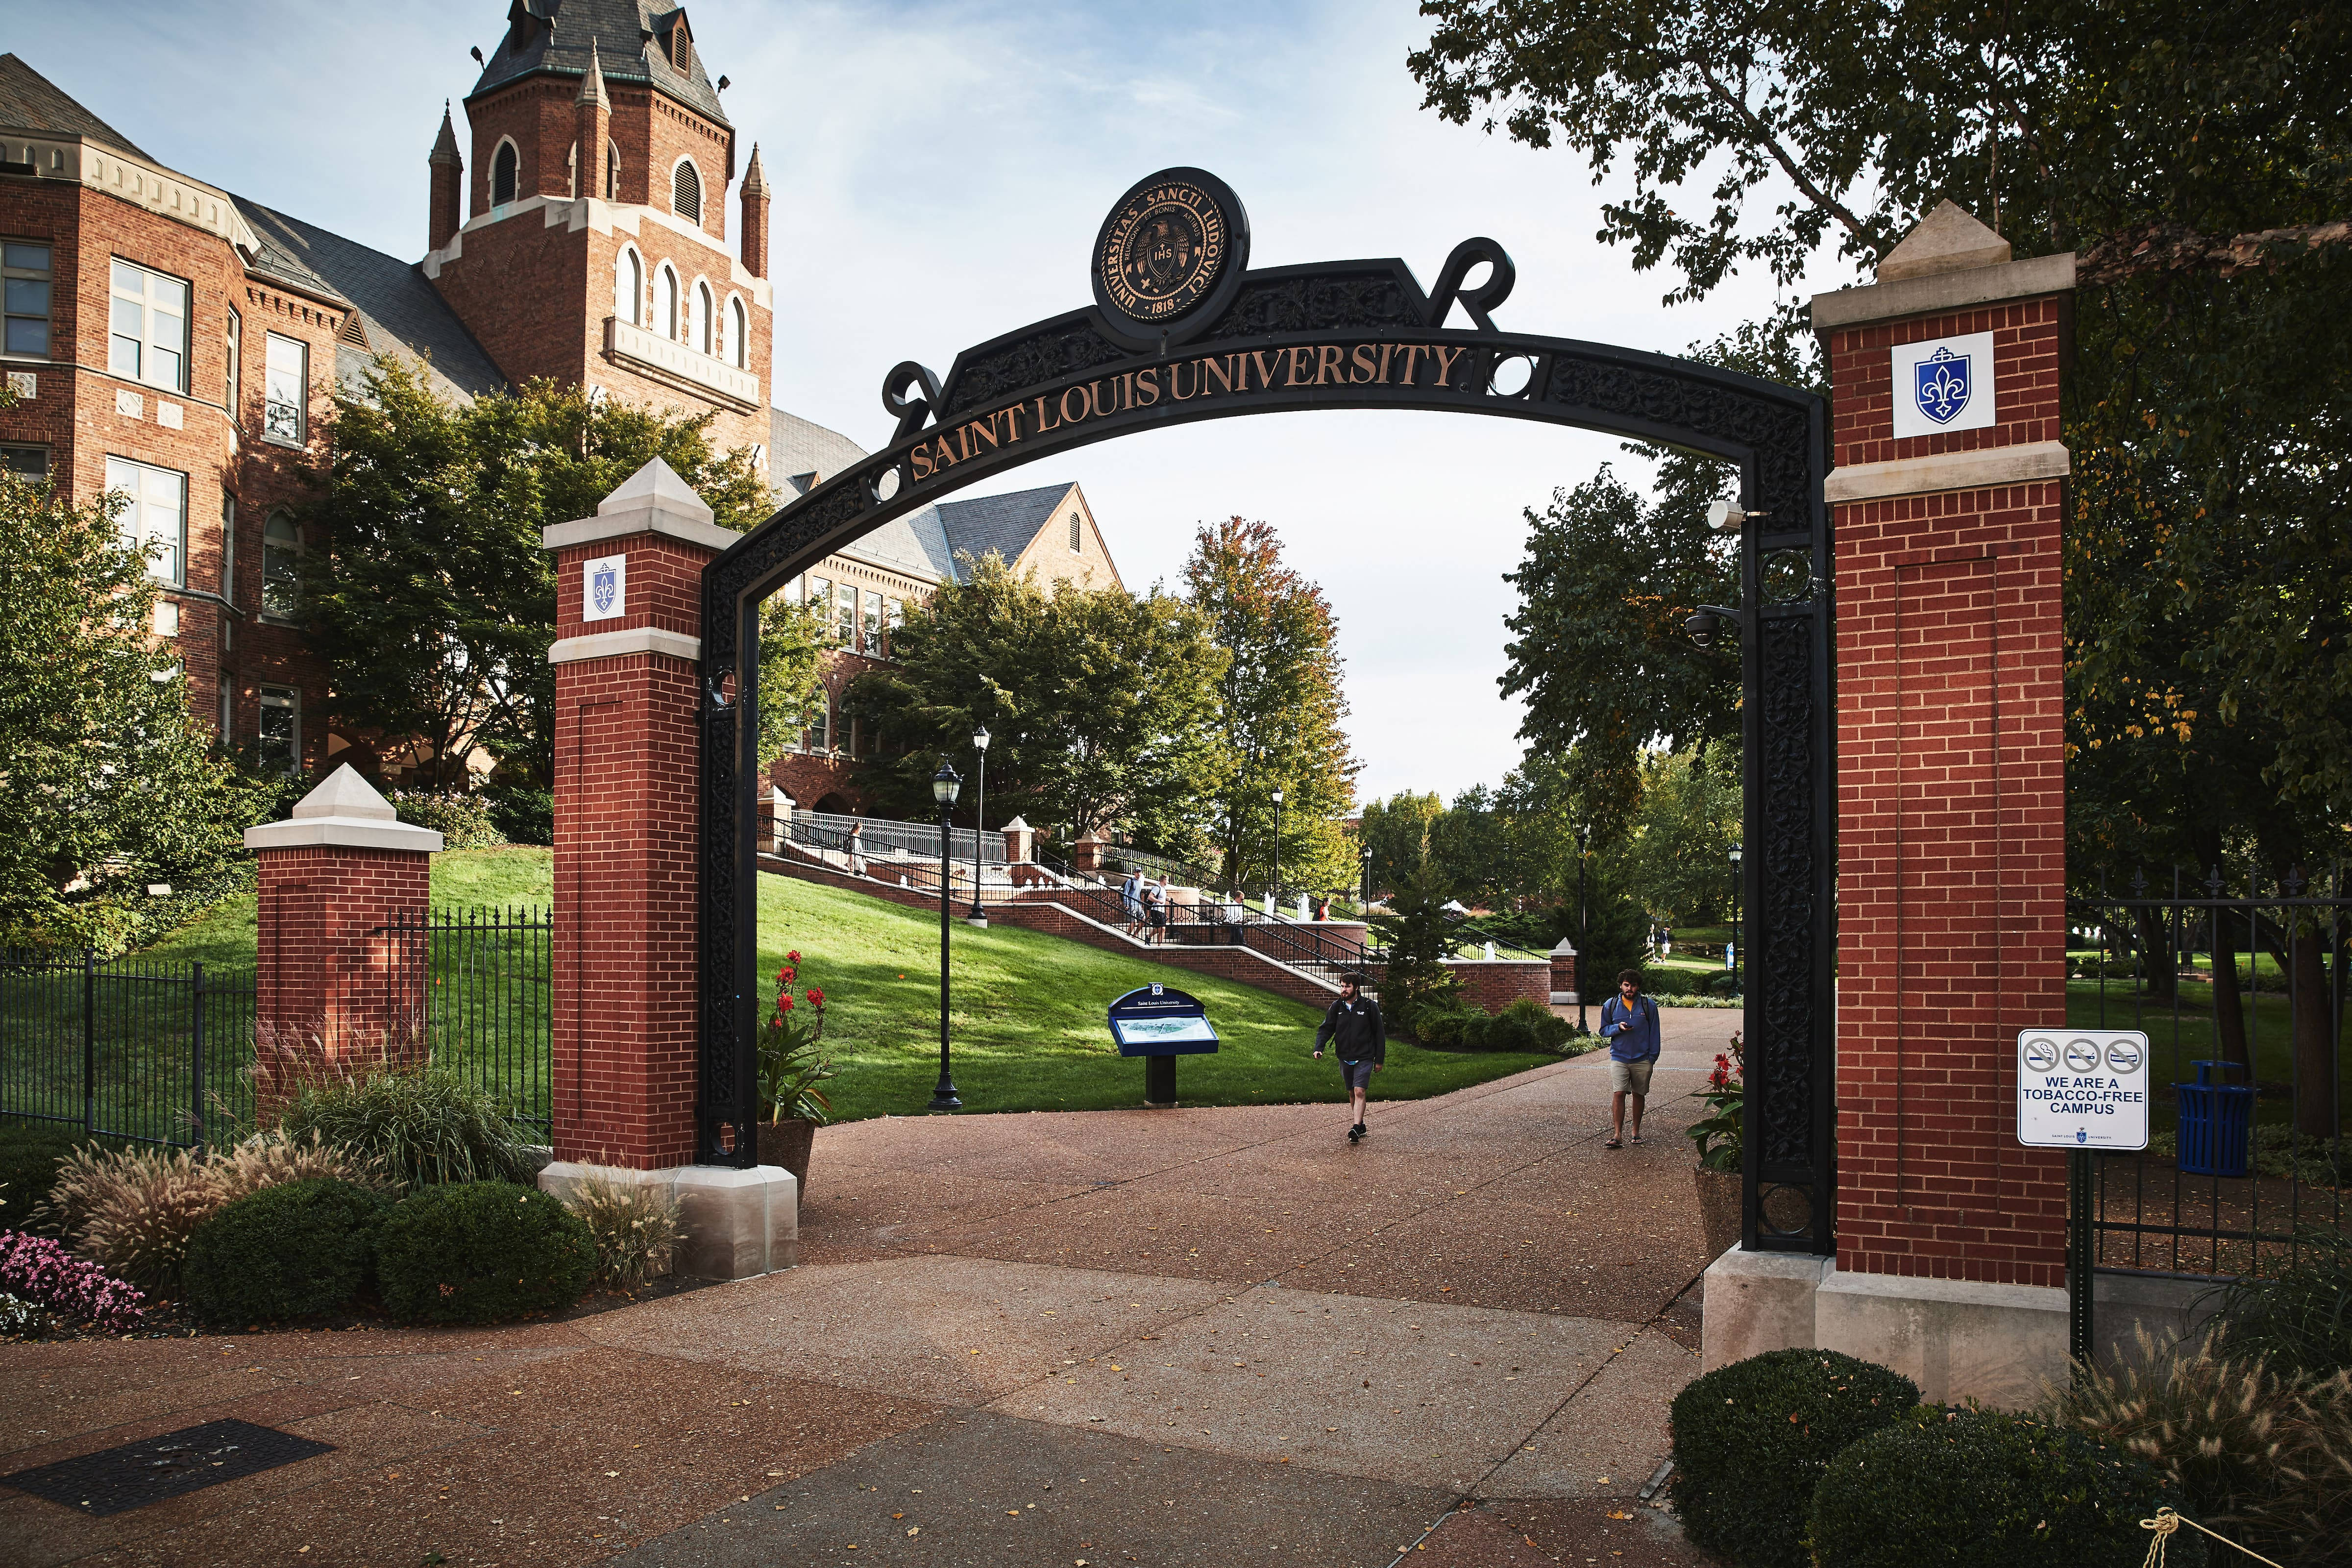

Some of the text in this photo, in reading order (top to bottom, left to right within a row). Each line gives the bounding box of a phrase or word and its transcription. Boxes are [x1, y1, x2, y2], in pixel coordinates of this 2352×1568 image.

[1125, 225, 1141, 261] RELIGIONI
[1154, 206, 1176, 215] BONIS
[1183, 212, 1201, 237] ARTIBUS
[1107, 188, 1220, 309] UNIVERSITAS SANCTI LUDOVICI
[1154, 248, 1172, 261] IHS
[1152, 298, 1175, 314] 1818
[910, 344, 1467, 482] SAINT LOUIS UNIVERSITY
[2045, 1077, 2119, 1089] WE ARE A
[2023, 1089, 2143, 1102] TOBACCO-FREE
[2050, 1102, 2115, 1114] CAMPUS
